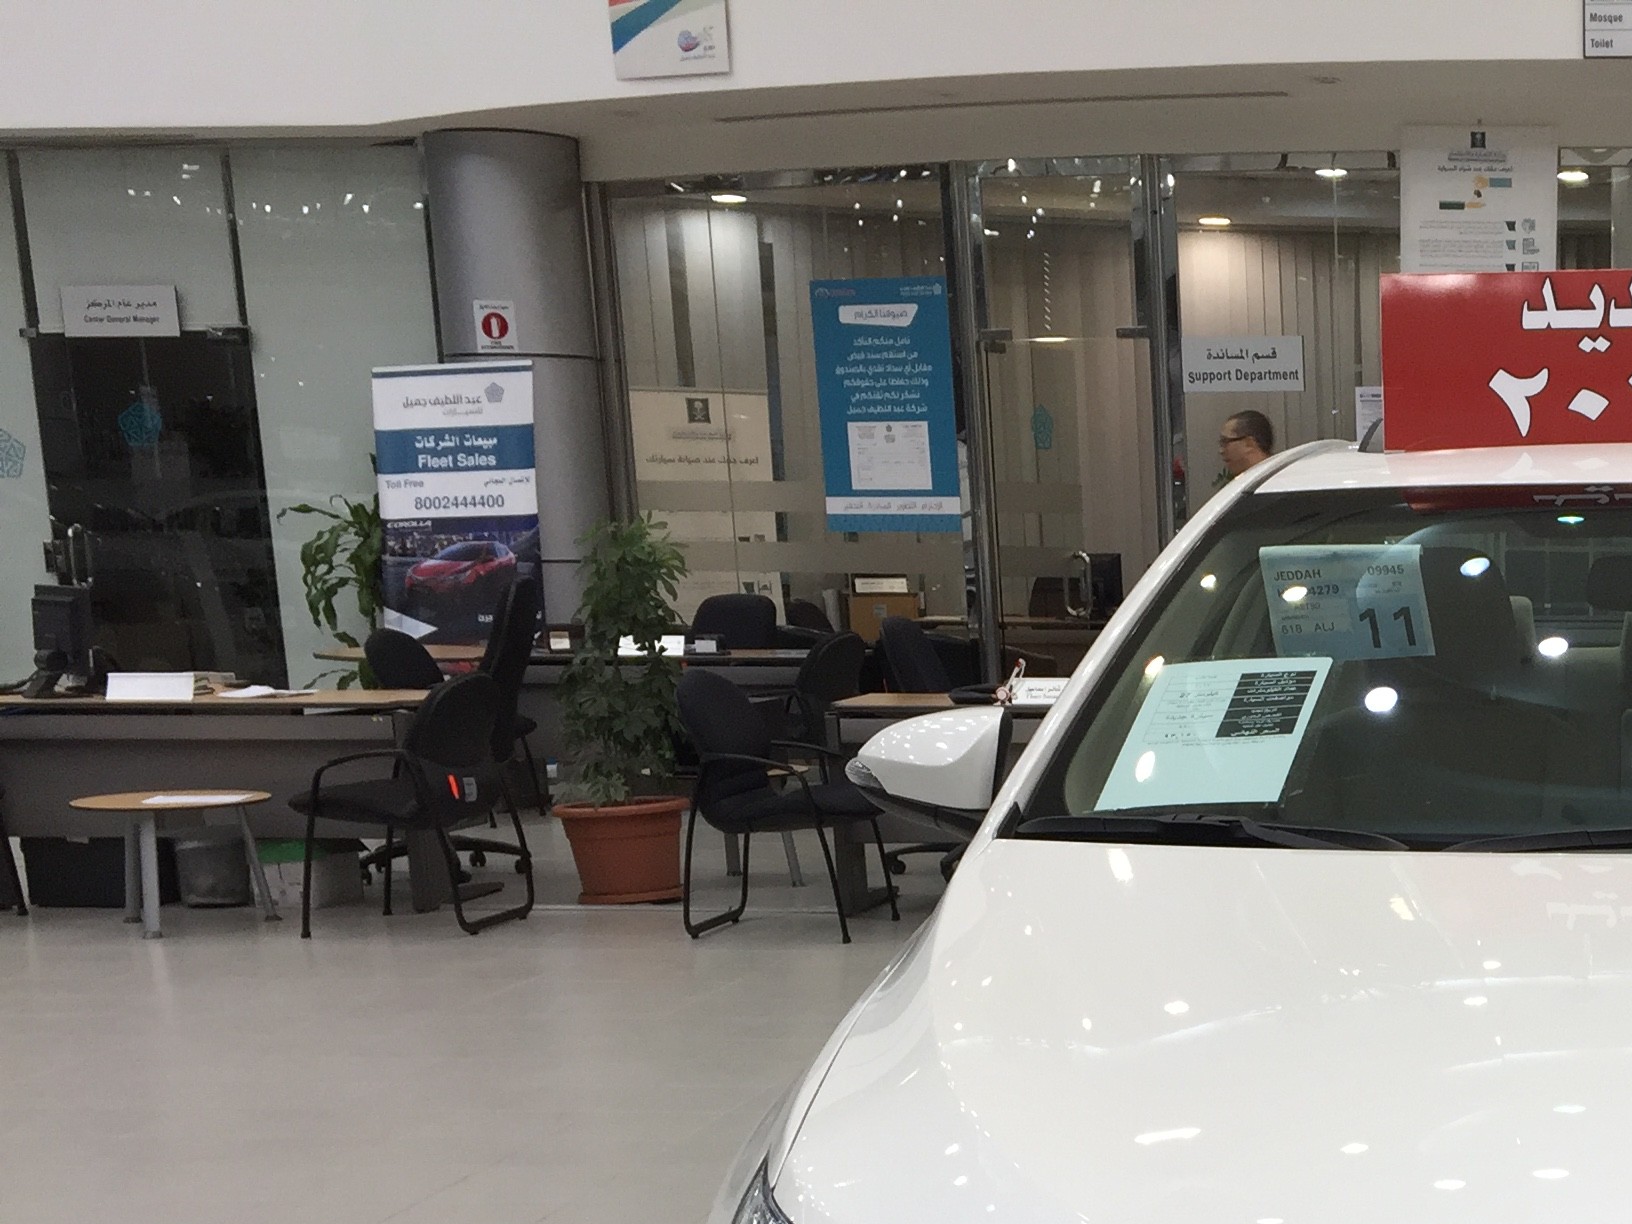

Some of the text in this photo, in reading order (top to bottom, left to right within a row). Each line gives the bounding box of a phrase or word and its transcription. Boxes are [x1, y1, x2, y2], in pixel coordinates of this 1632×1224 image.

[1589, 12, 1623, 24] Mosque
[1590, 38, 1614, 49] Toilet
[1206, 347, 1277, 364] قسم المساندة
[1188, 368, 1299, 384] Support Department
[402, 394, 482, 409] عبد اللطيف جميل
[414, 433, 498, 451] مبيعات الشركات
[417, 453, 497, 469] Fleet Sales
[385, 478, 424, 490] Toll Free
[414, 494, 505, 510] 8002444400
[386, 519, 433, 530] COROLLA
[1274, 564, 1405, 582] JEDDAH 09945
[1314, 621, 1335, 633] ALJ
[1359, 606, 1417, 649] 11
